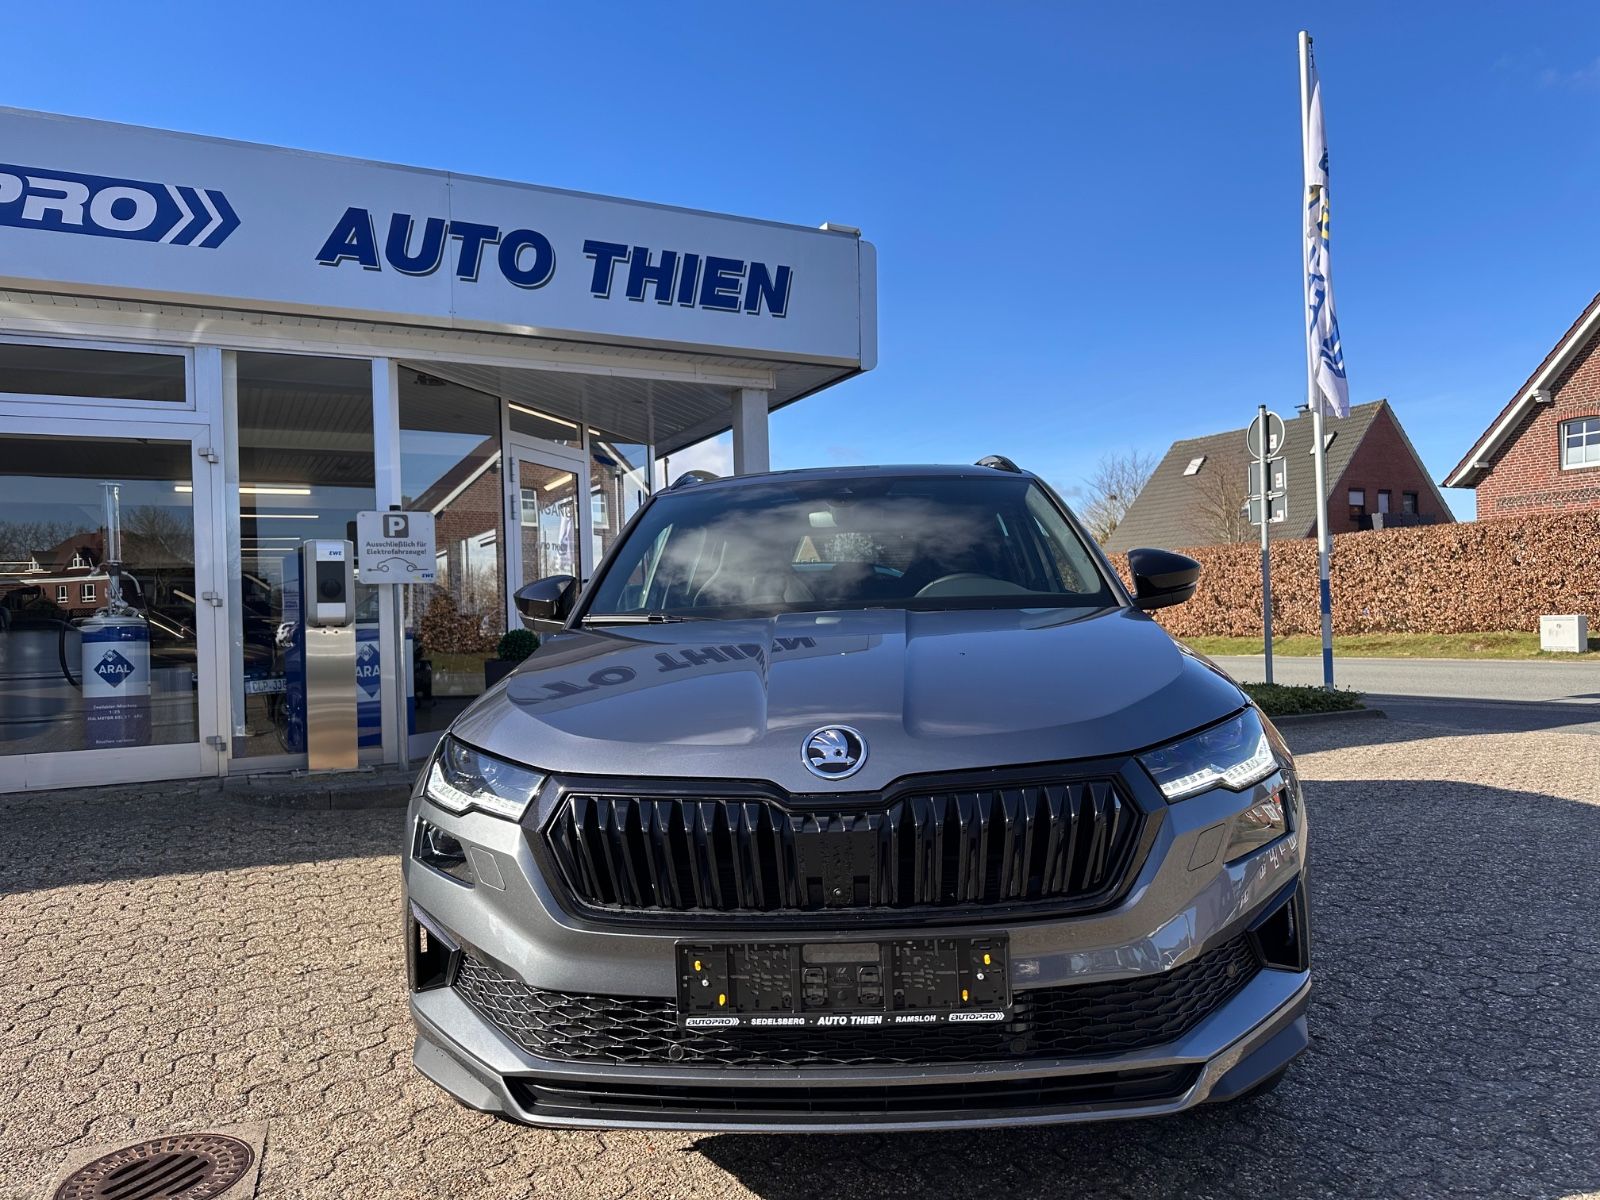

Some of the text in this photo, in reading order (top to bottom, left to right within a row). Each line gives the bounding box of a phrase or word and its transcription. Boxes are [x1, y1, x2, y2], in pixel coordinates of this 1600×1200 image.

[315, 206, 794, 319] AUTO THIEN
[388, 516, 406, 537] P
[366, 548, 427, 556] Elektrofahrzeuge!
[98, 664, 131, 674] ARAL
[750, 1017, 806, 1026] SEDELSBERG
[817, 1016, 848, 1025] AUTO
[850, 1015, 883, 1025] THIEN
[895, 1014, 937, 1023] RAMSLOH
